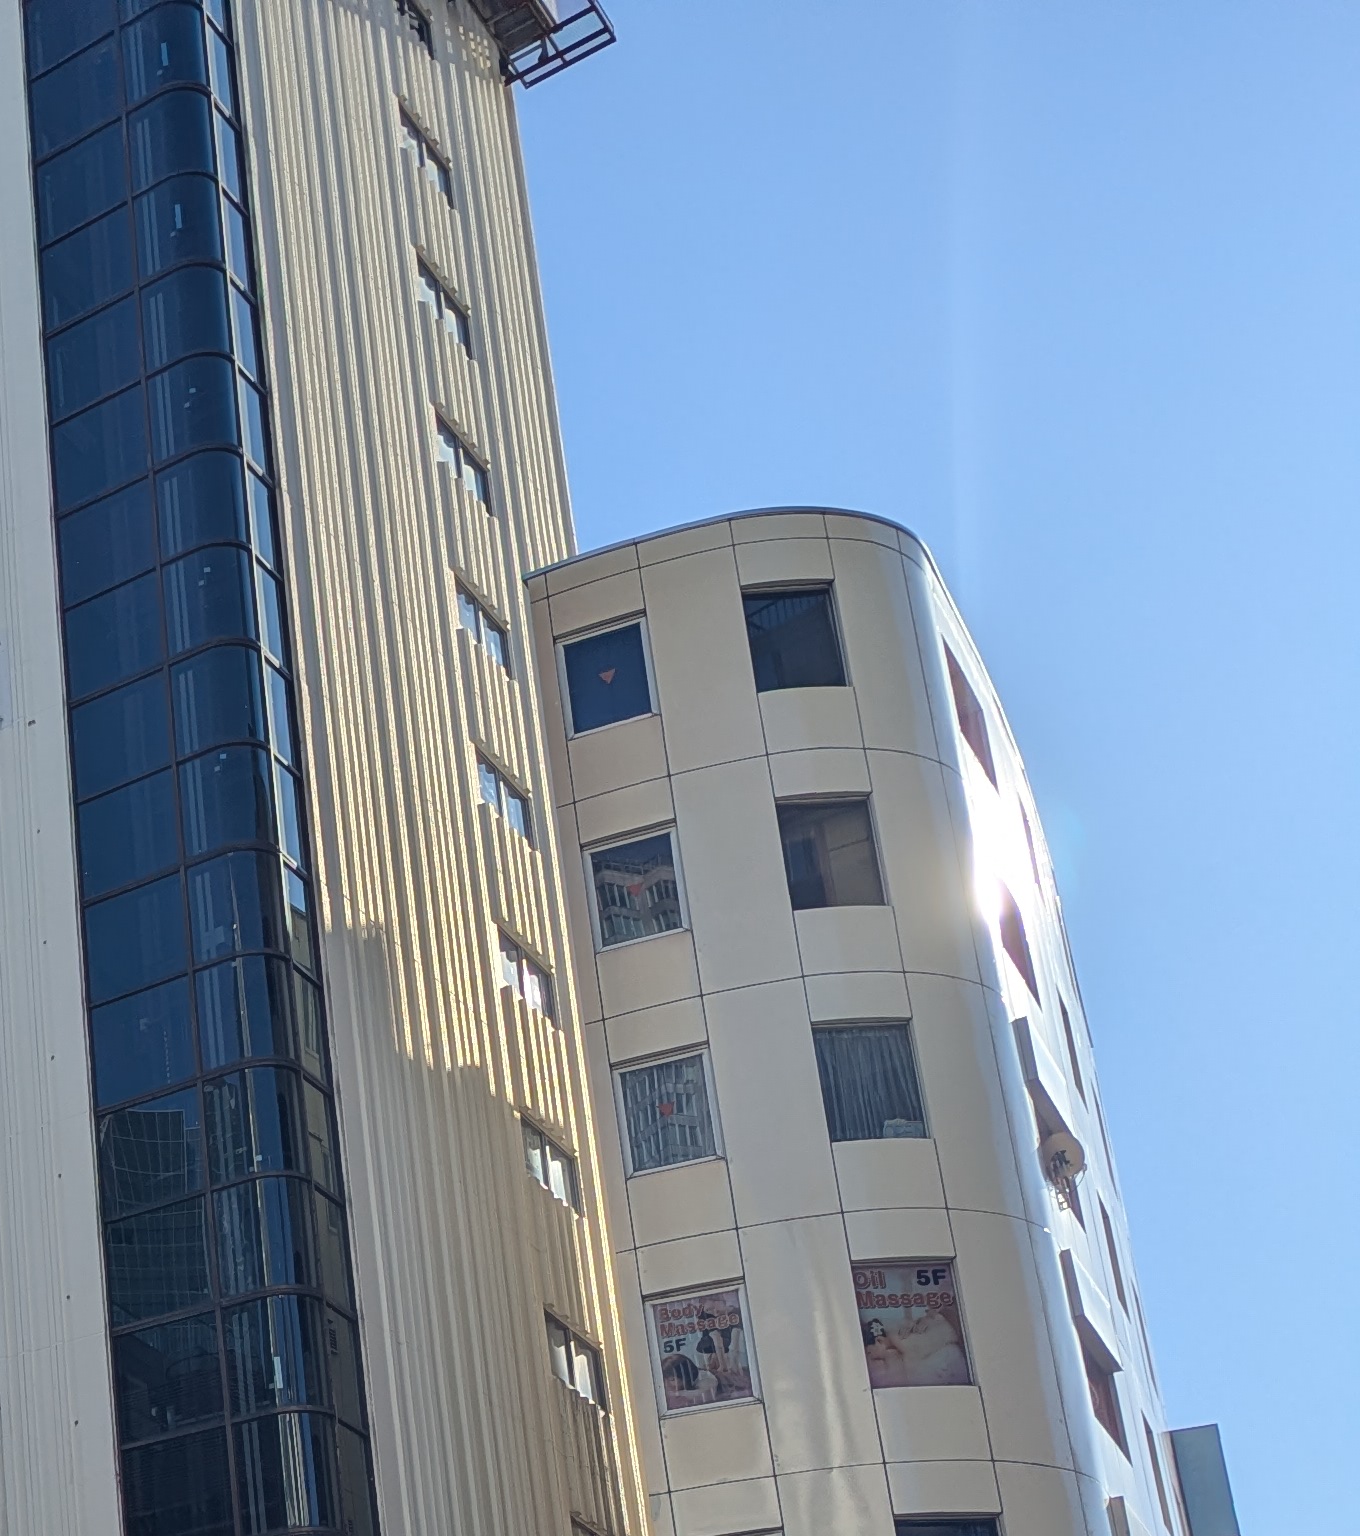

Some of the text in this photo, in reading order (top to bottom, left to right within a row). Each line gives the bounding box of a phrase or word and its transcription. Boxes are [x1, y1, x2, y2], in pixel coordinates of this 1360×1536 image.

[854, 1271, 887, 1290] Oil
[916, 1268, 947, 1286] 5F
[856, 1290, 956, 1310] Massage
[659, 1303, 704, 1323] Body
[660, 1312, 740, 1338] Massage
[663, 1338, 687, 1354] 5F
